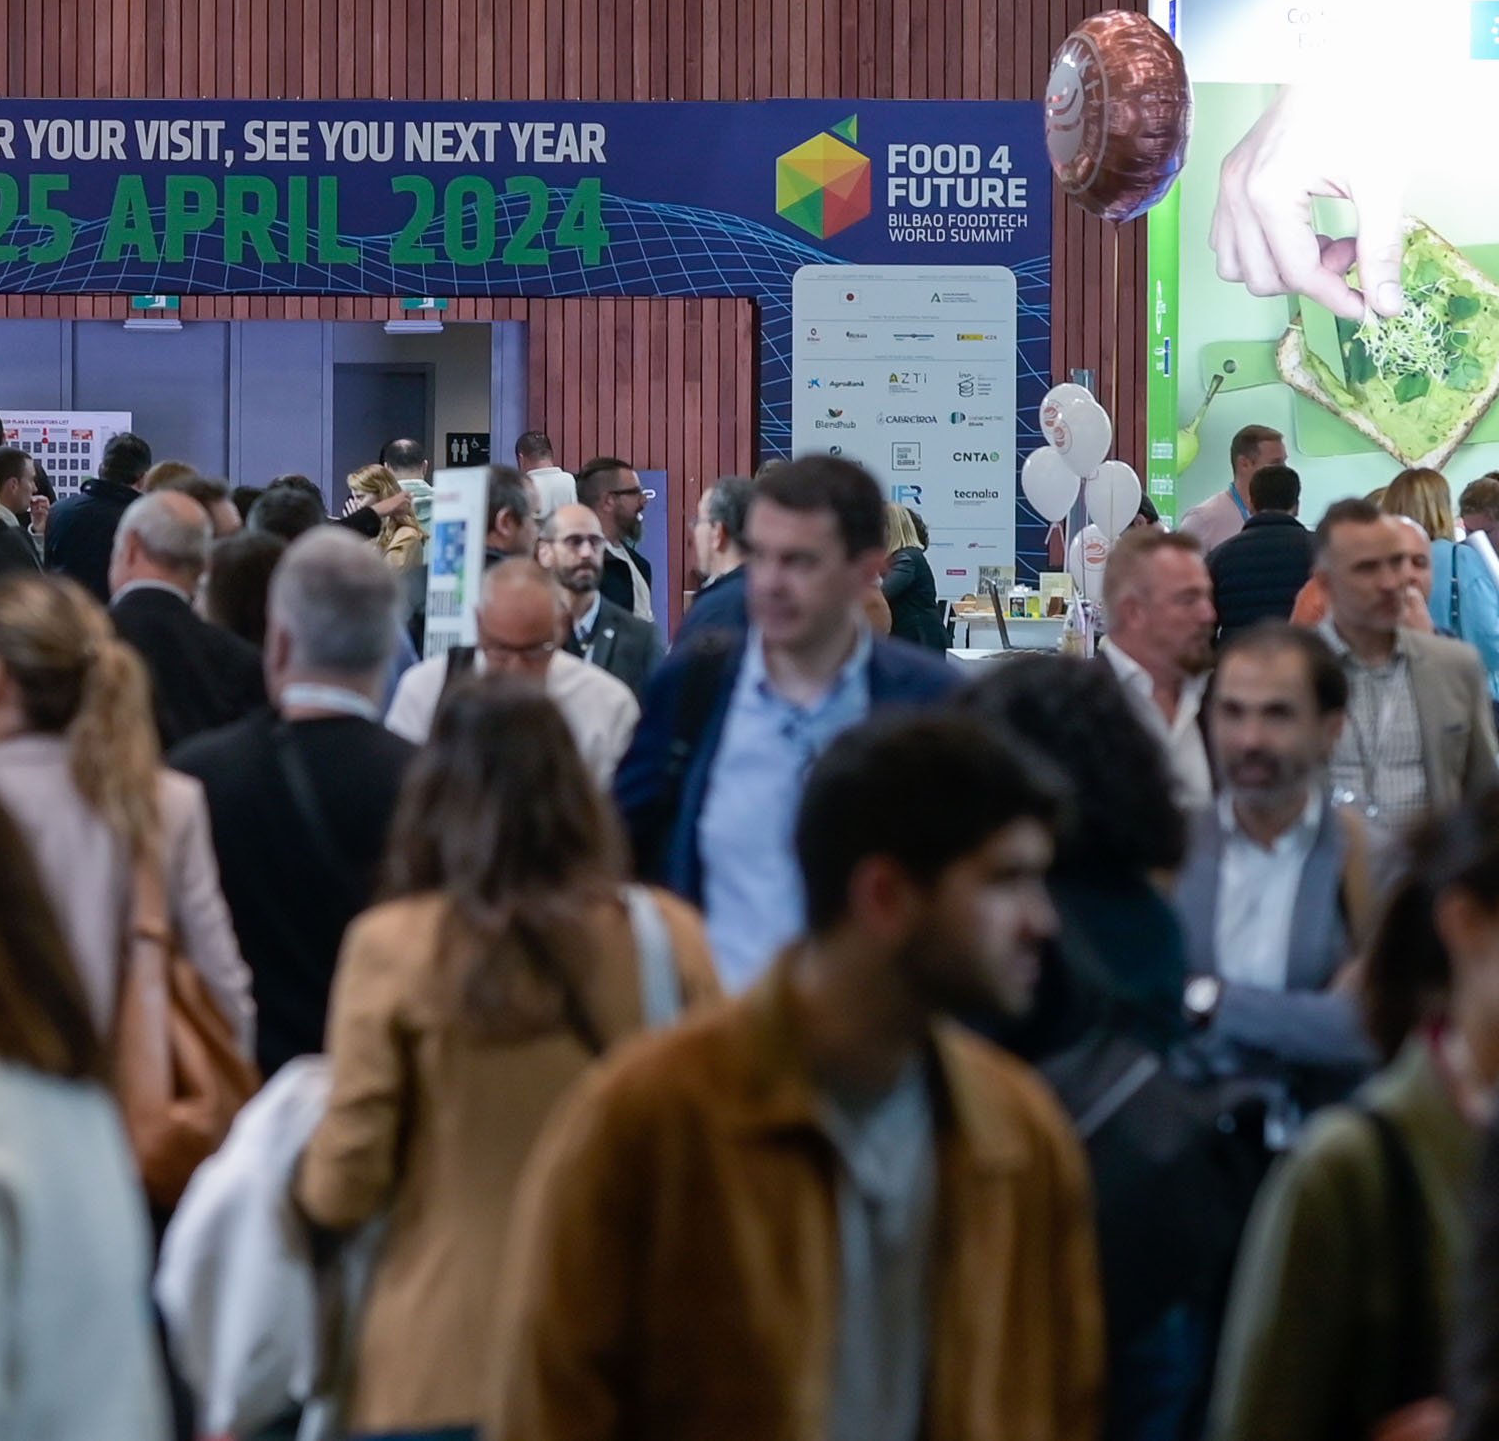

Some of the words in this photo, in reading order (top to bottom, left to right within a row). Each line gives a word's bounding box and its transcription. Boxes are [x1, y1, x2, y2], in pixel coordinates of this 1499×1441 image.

[22, 119, 128, 161] YOUR
[135, 120, 233, 166] VISIT,
[244, 121, 314, 163] SEE
[320, 121, 394, 163] YOU
[405, 121, 510, 163] NEXT
[513, 122, 606, 164] YEAR
[888, 144, 981, 174] FOOD
[989, 145, 1012, 174] 4
[888, 177, 1027, 207] FUTURE
[99, 175, 359, 264] APRIL
[389, 175, 610, 265] 2024
[888, 213, 943, 227] BILBAO
[948, 214, 1028, 228] FOODTECH
[889, 228, 946, 242] WORLD
[950, 229, 1014, 242] SUMMIT
[953, 452, 989, 462] CNTA
